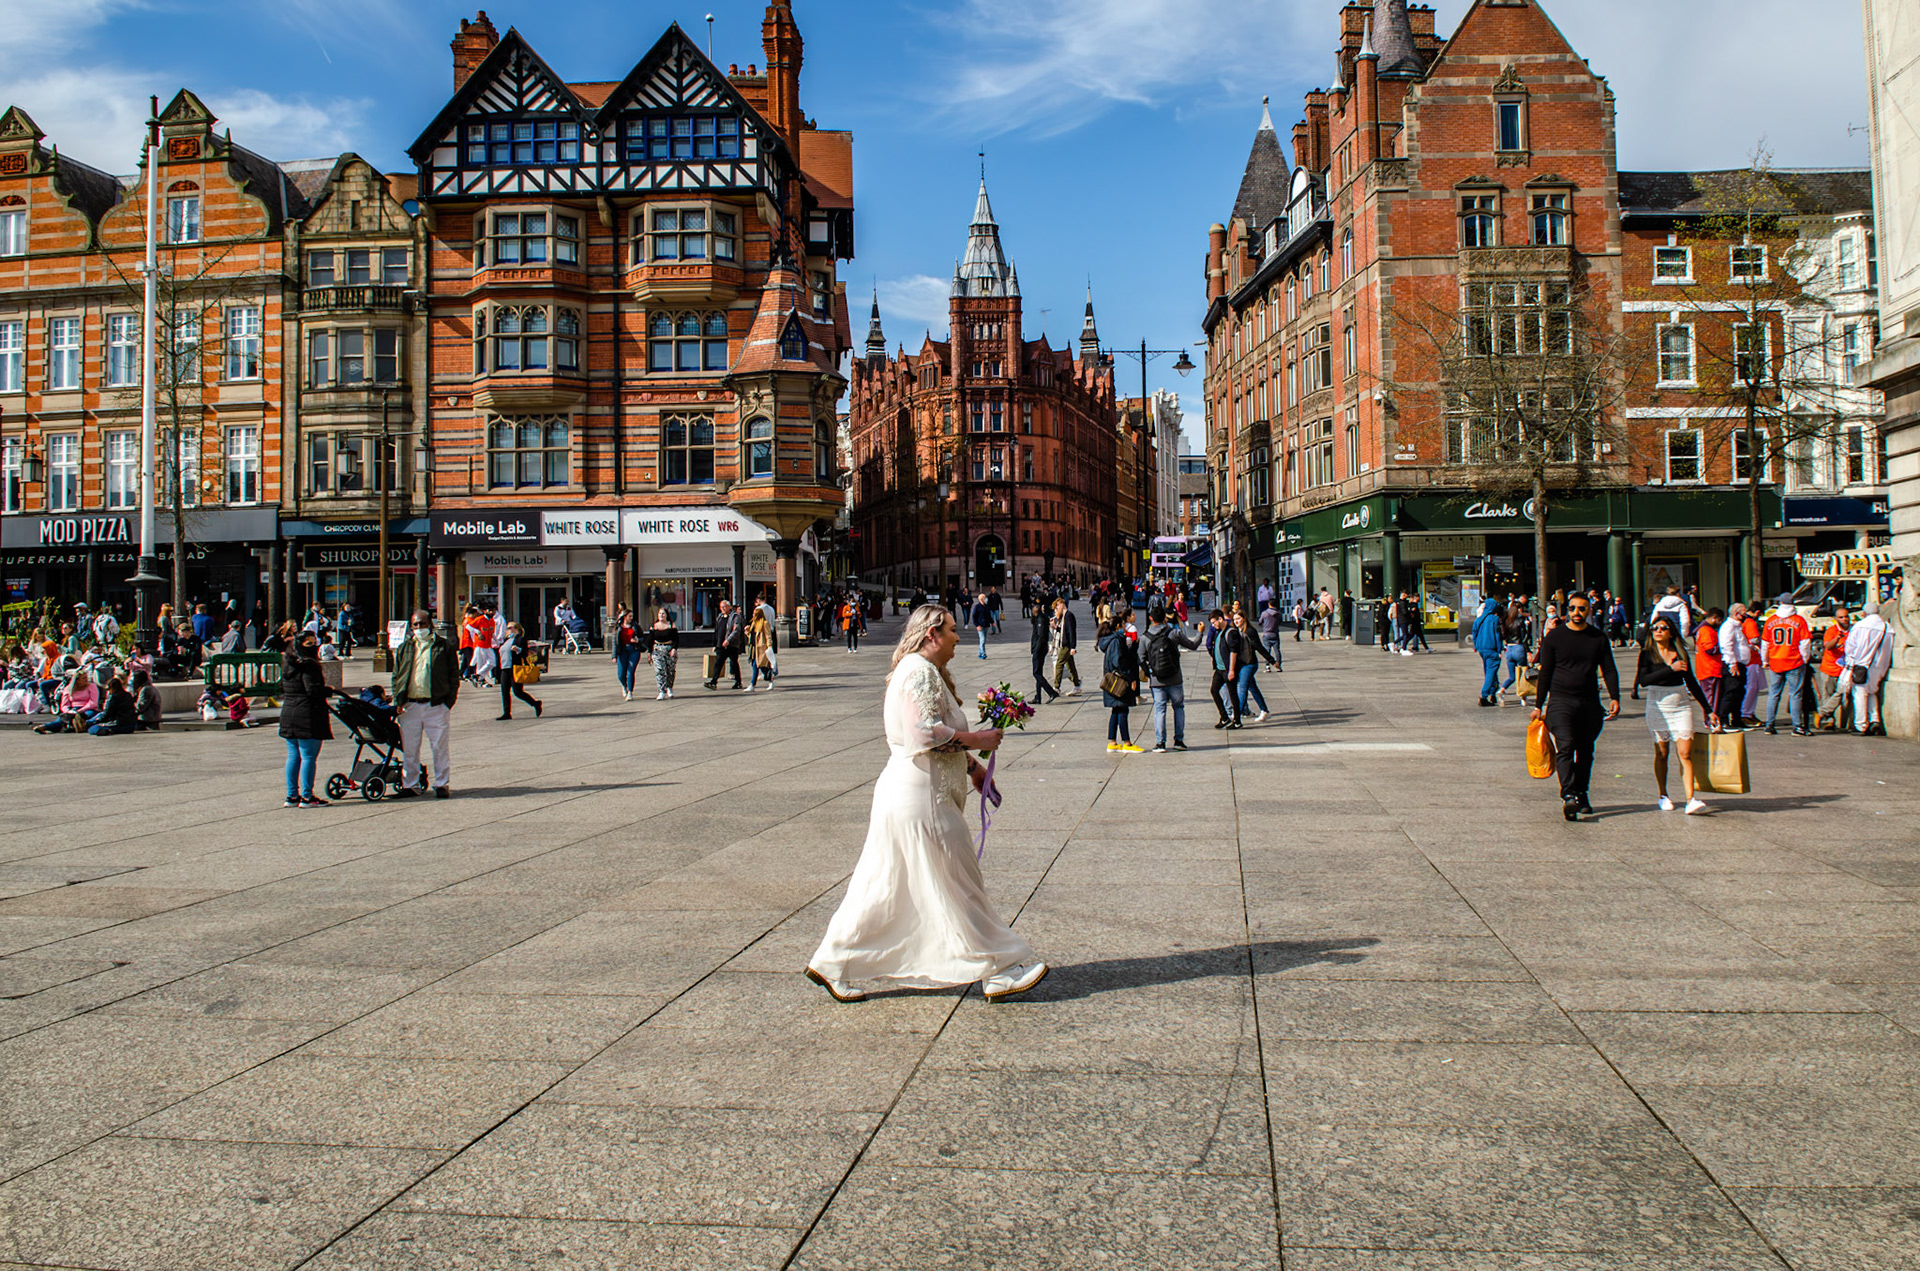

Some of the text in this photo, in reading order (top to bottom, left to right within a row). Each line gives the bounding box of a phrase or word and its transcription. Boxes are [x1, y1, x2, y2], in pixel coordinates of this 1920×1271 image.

[1464, 502, 1518, 518] Clarks
[40, 517, 128, 543] MOD PIZZA
[323, 524, 363, 533] CHIROPODY
[443, 520, 526, 535] Mobile Lab
[545, 520, 616, 534] WHITE ROSE
[638, 519, 739, 533] WHITE ROSE WR6
[1763, 544, 1796, 553] Barber
[0, 554, 87, 565] UPERFAST
[159, 551, 206, 560] SAAD
[320, 549, 411, 563] SHUROPDY
[484, 555, 520, 566] Mobile
[751, 554, 769, 563] WHITE
[751, 562, 767, 571] ROSE
[1772, 627, 1793, 646] 01
